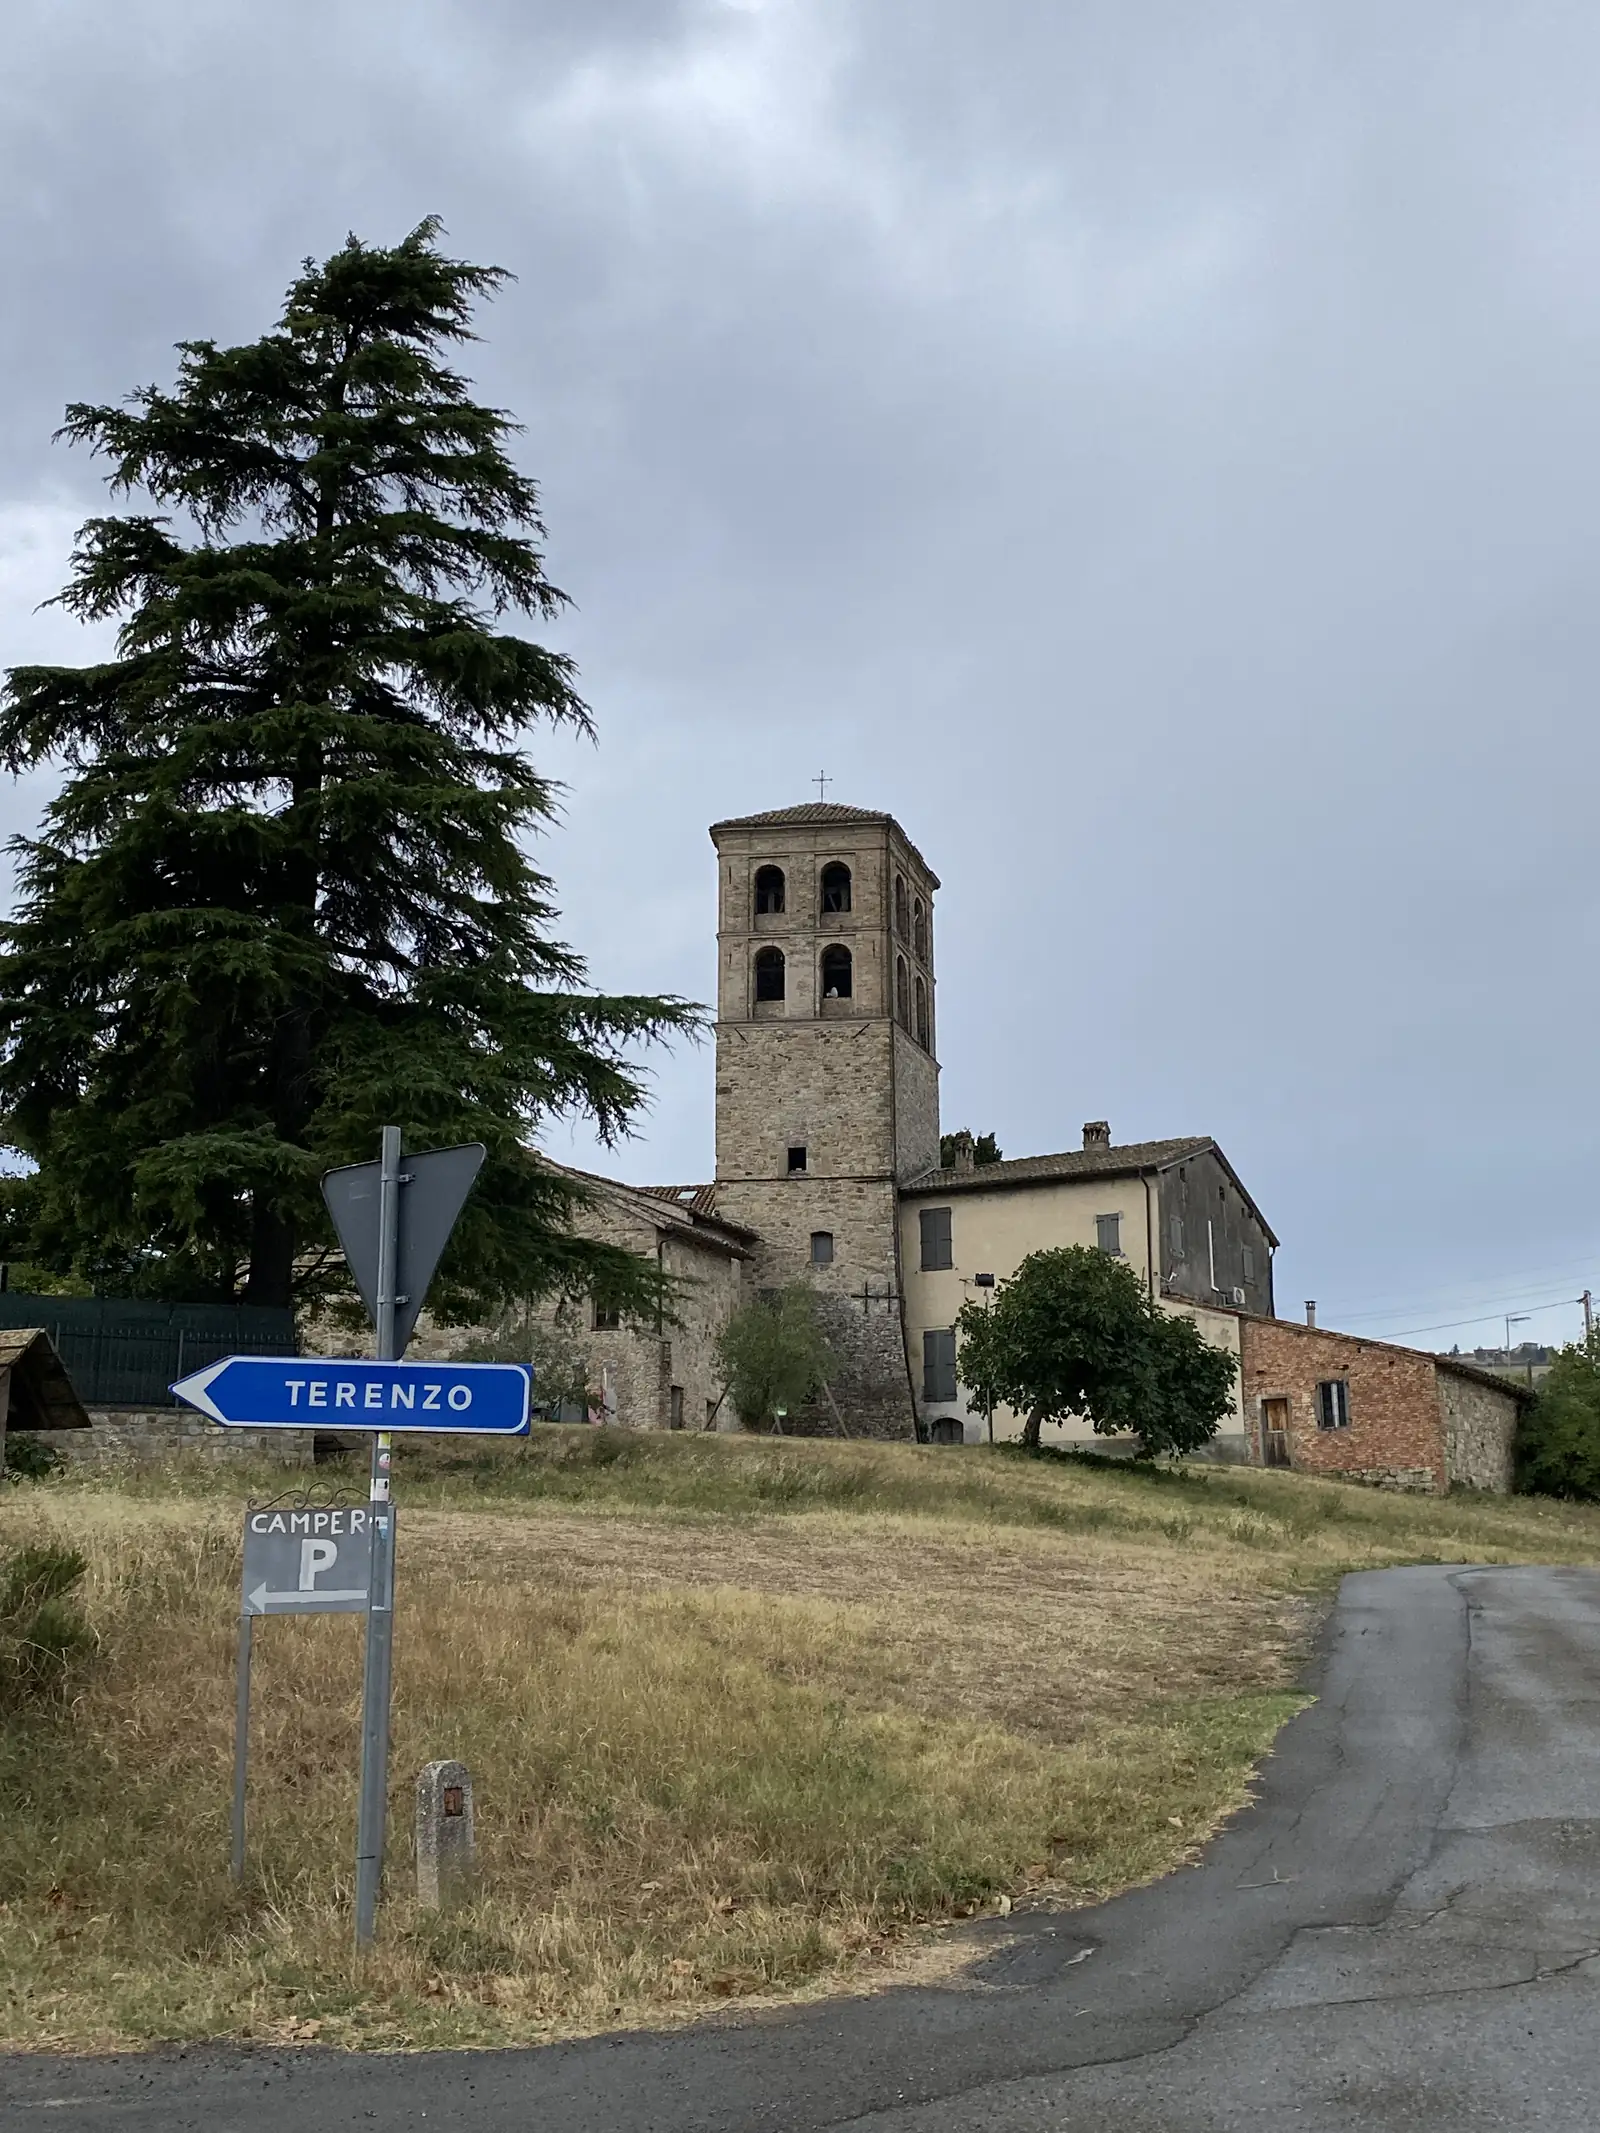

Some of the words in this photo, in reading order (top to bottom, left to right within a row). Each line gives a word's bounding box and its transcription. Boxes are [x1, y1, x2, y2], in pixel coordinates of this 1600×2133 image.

[285, 1381, 472, 1411] TERENZO
[251, 1509, 366, 1535] CAMPER
[299, 1538, 338, 1591] P
